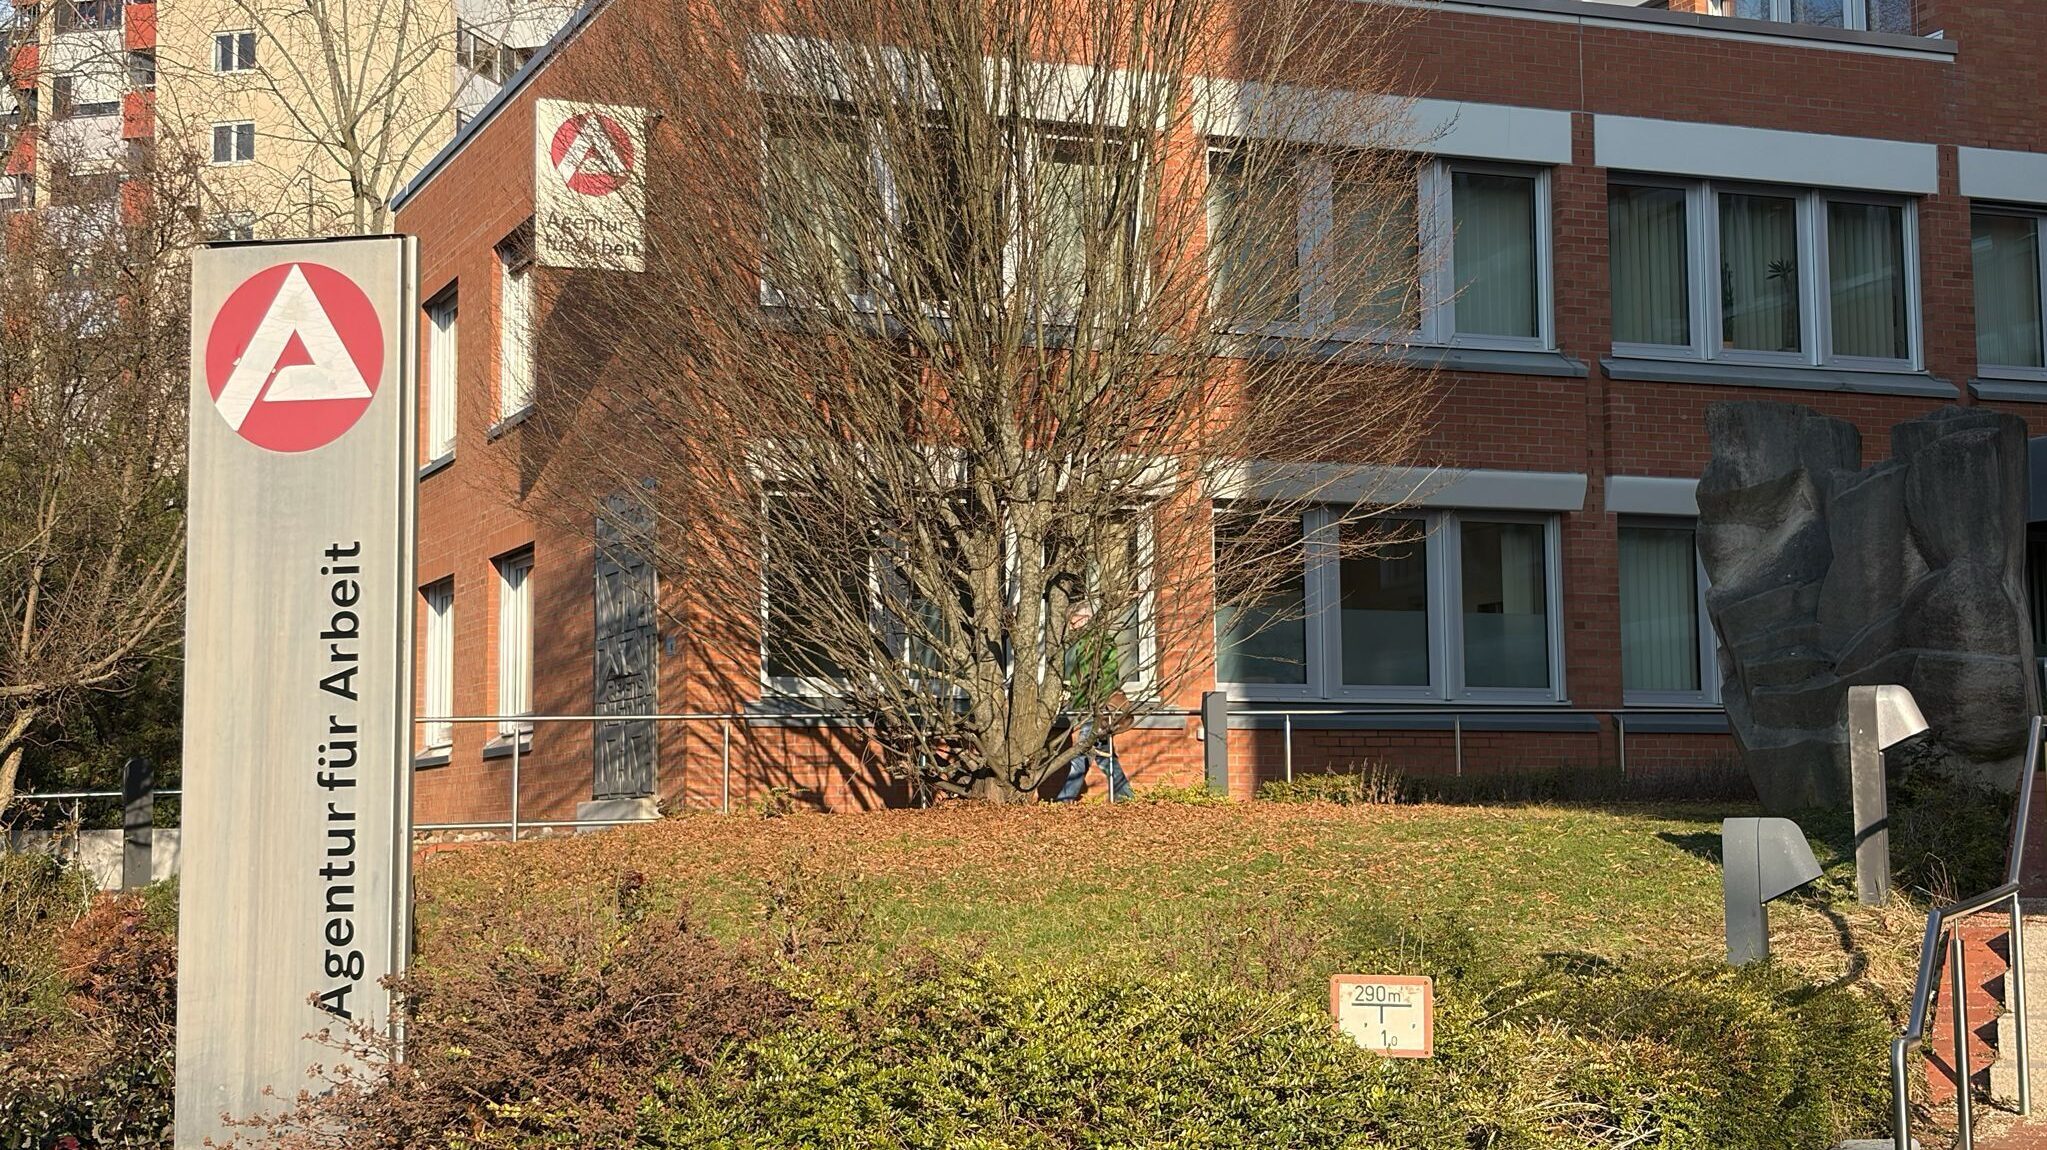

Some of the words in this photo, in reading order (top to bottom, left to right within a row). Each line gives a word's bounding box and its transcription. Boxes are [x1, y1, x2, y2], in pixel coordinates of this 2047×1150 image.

[547, 211, 627, 233] Agentur
[319, 541, 361, 702] Arbeit
[317, 715, 358, 791] für
[313, 802, 365, 1020] Agentur
